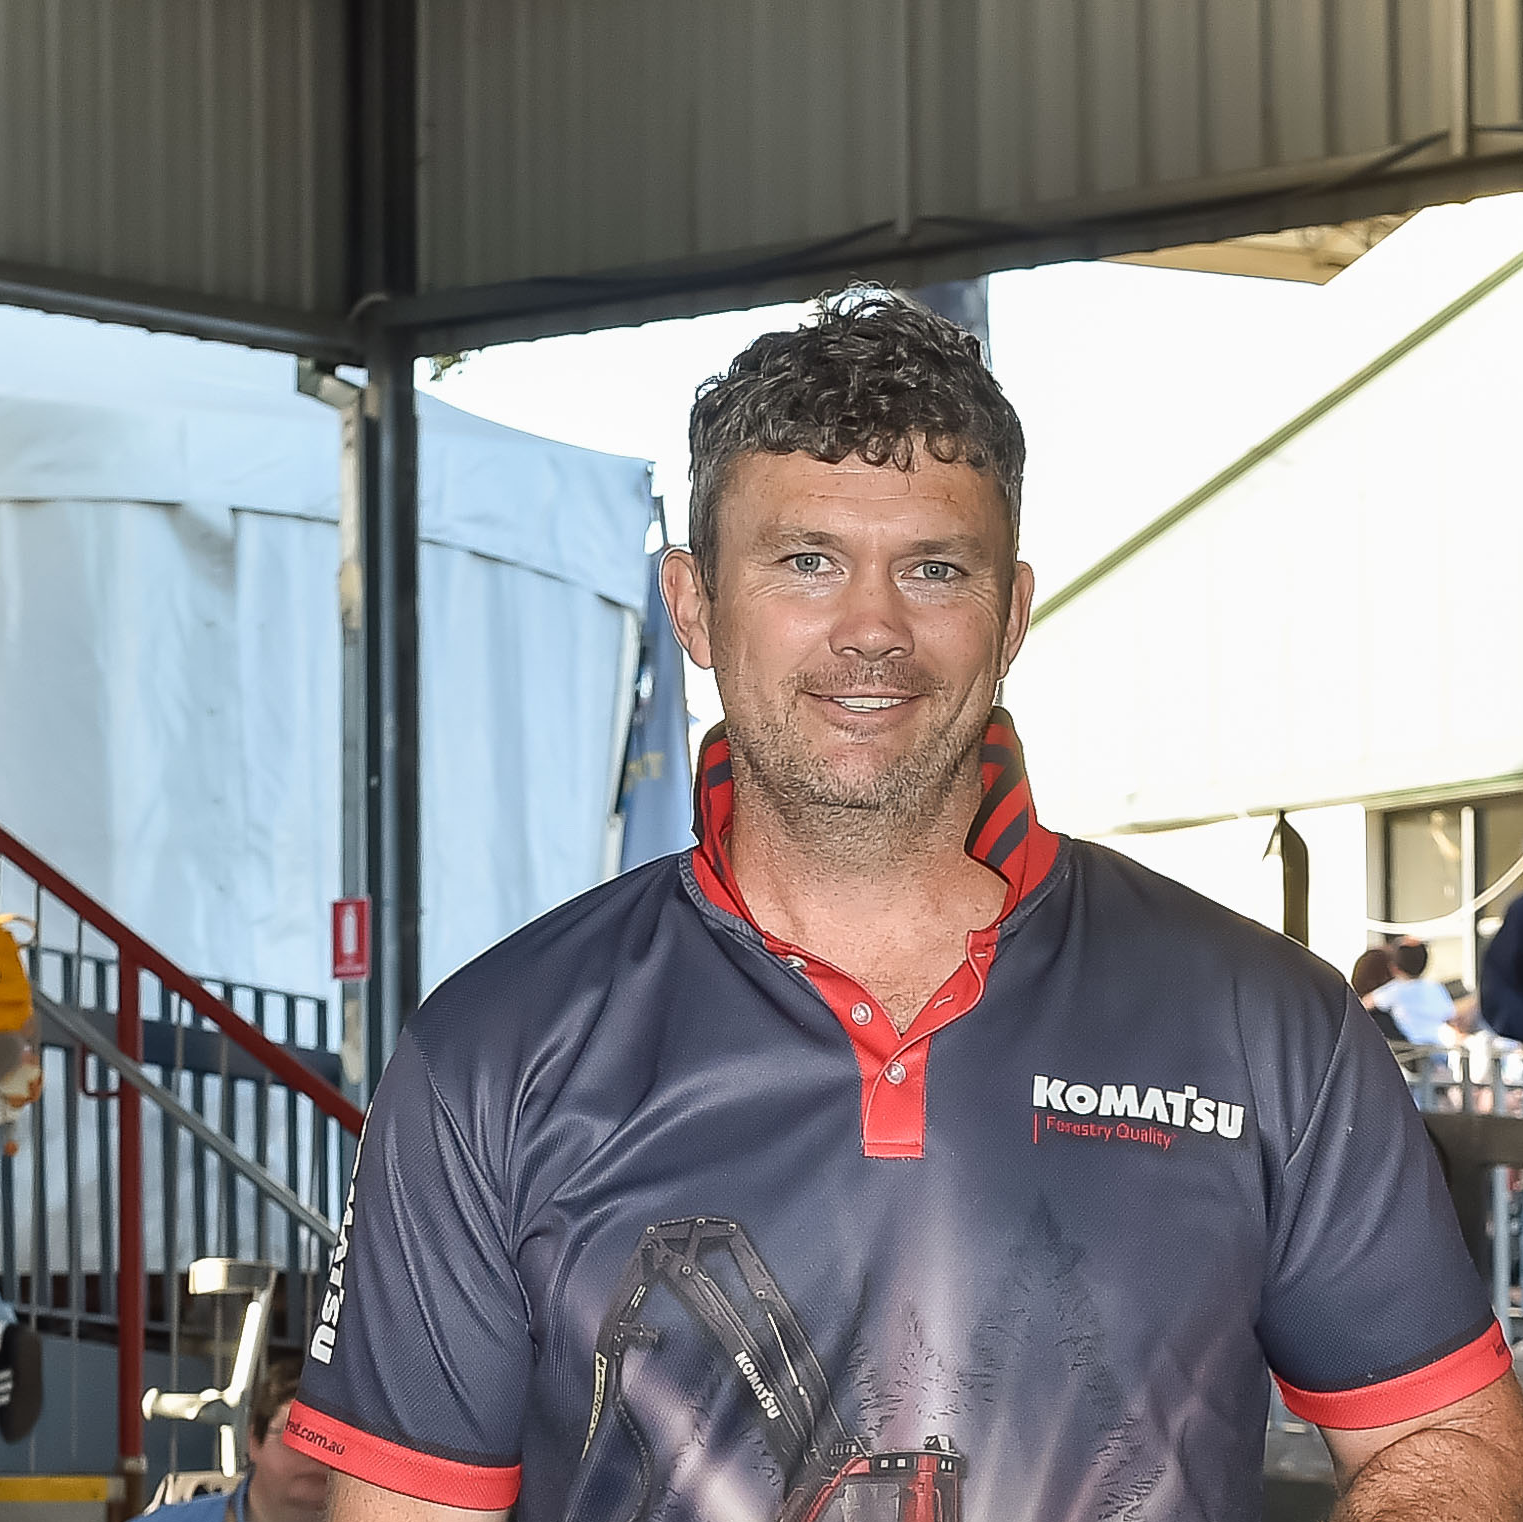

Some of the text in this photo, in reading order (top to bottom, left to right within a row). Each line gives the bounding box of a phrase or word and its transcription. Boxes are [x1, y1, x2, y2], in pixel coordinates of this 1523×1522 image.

[1031, 1074, 1245, 1140] KOMATSU
[1045, 1115, 1175, 1150] Forestry Quality
[733, 1350, 781, 1420] KOMATSU
